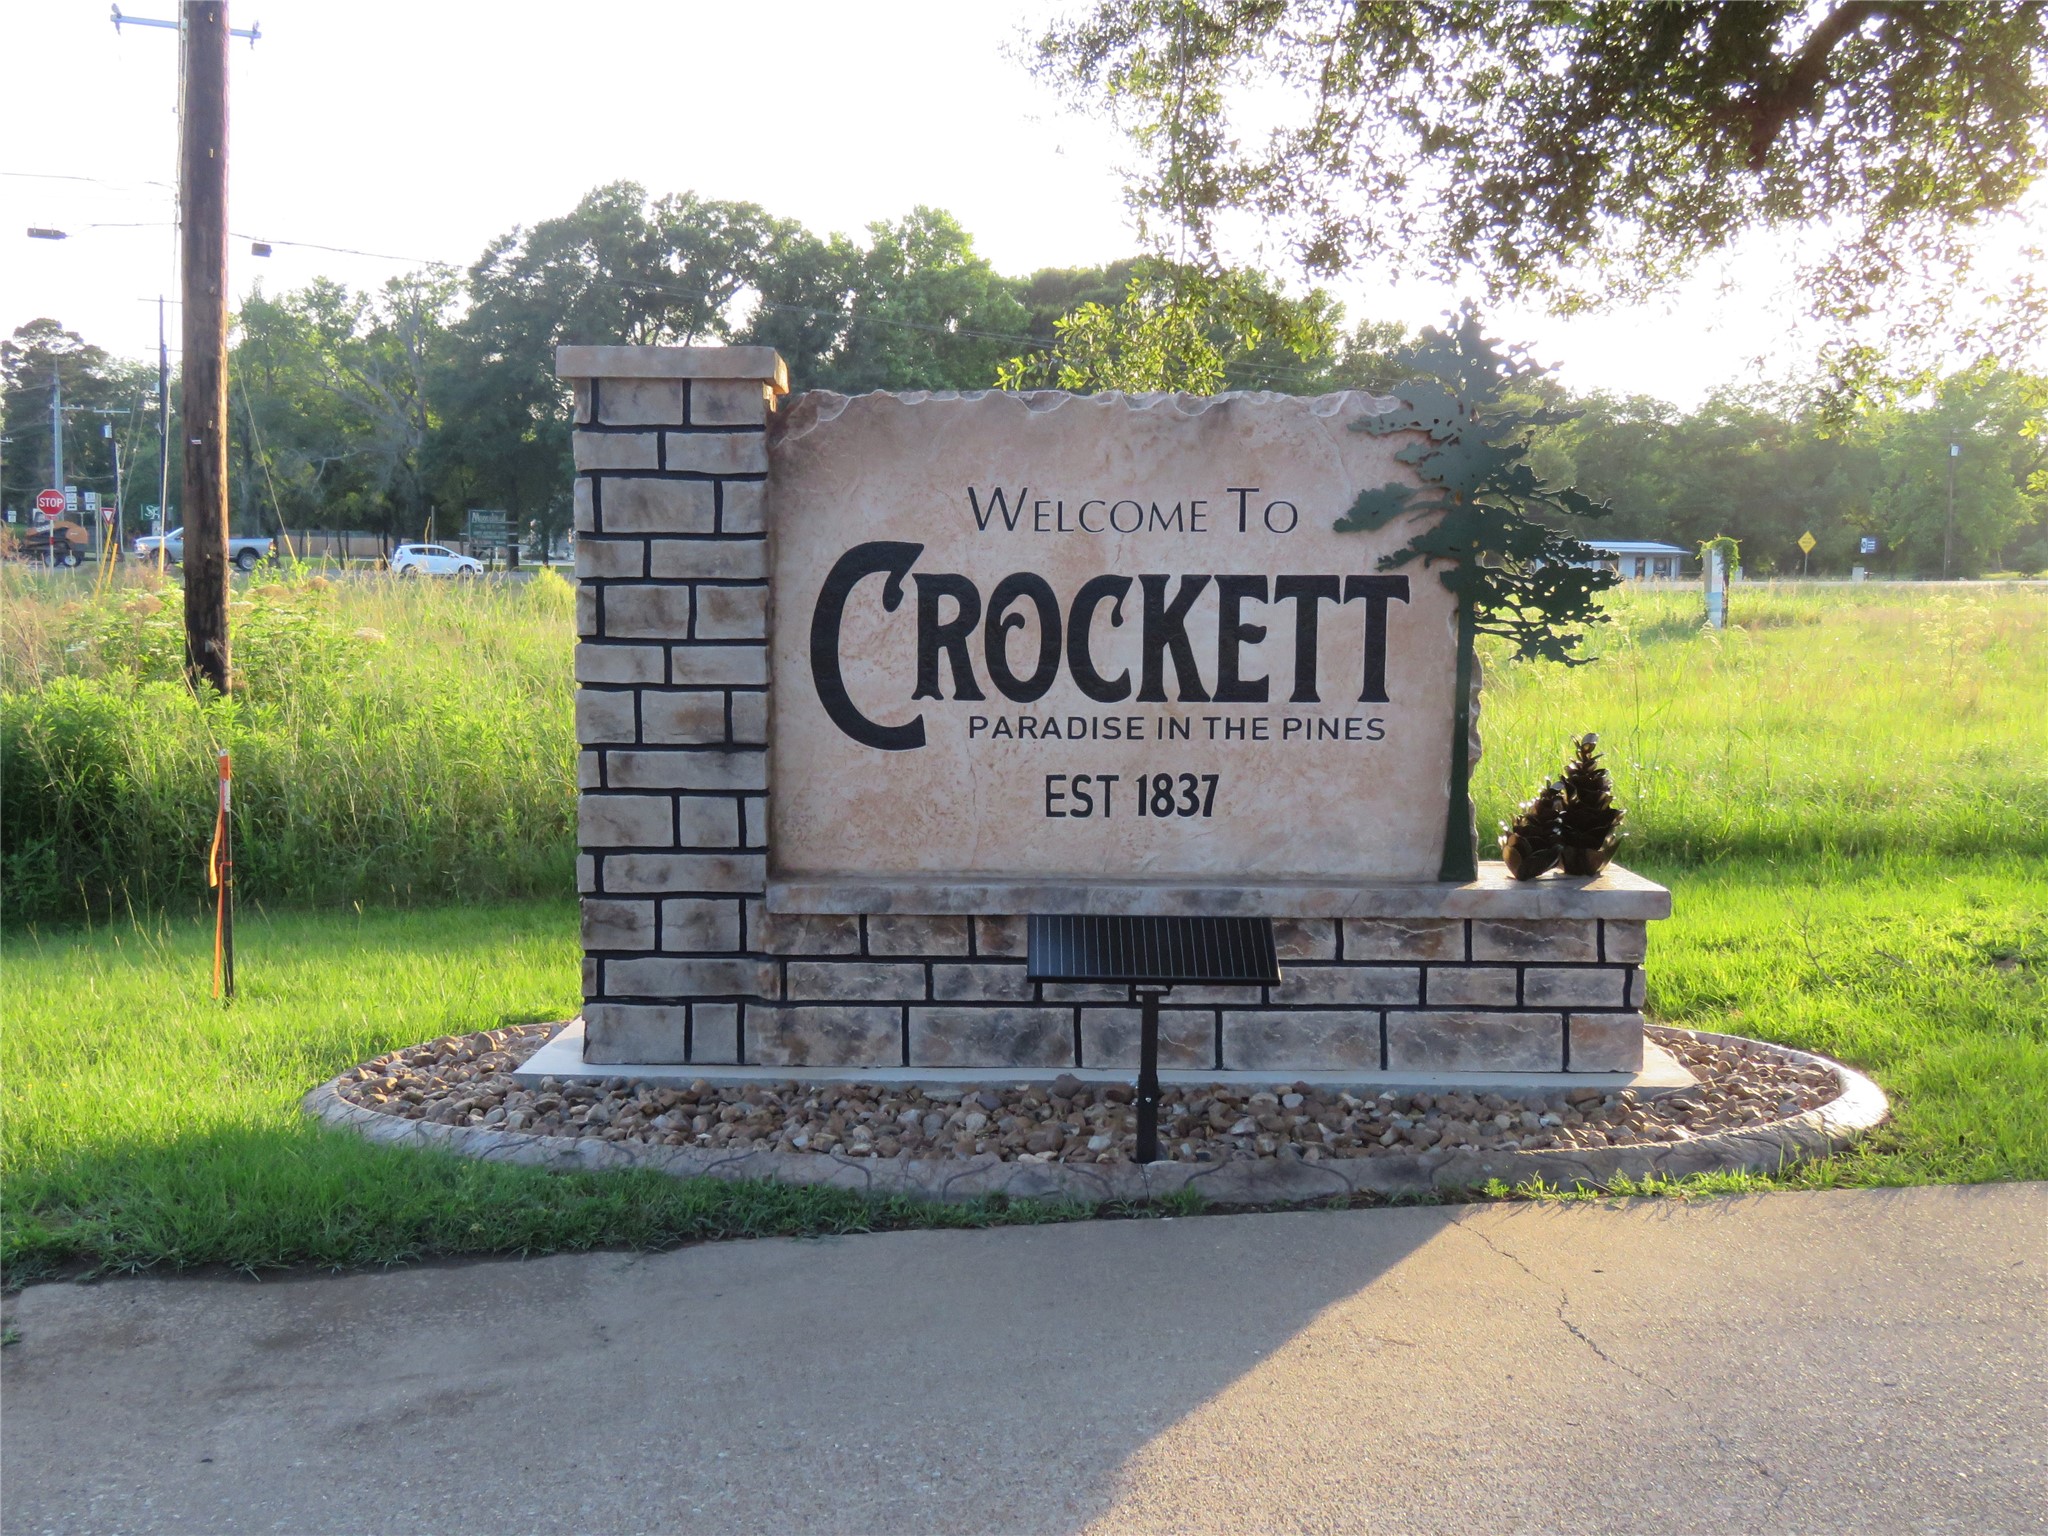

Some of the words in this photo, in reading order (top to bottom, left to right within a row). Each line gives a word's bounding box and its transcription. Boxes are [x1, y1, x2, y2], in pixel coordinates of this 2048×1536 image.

[39, 497, 64, 508] STOP
[810, 541, 1411, 751] CROCKETT
[969, 715, 1144, 741] PARADISE
[1157, 716, 1191, 741] IN
[1203, 716, 1270, 741] THE
[1282, 717, 1386, 742] PINES
[1045, 773, 1120, 818] EST
[1135, 773, 1220, 818] 1837
